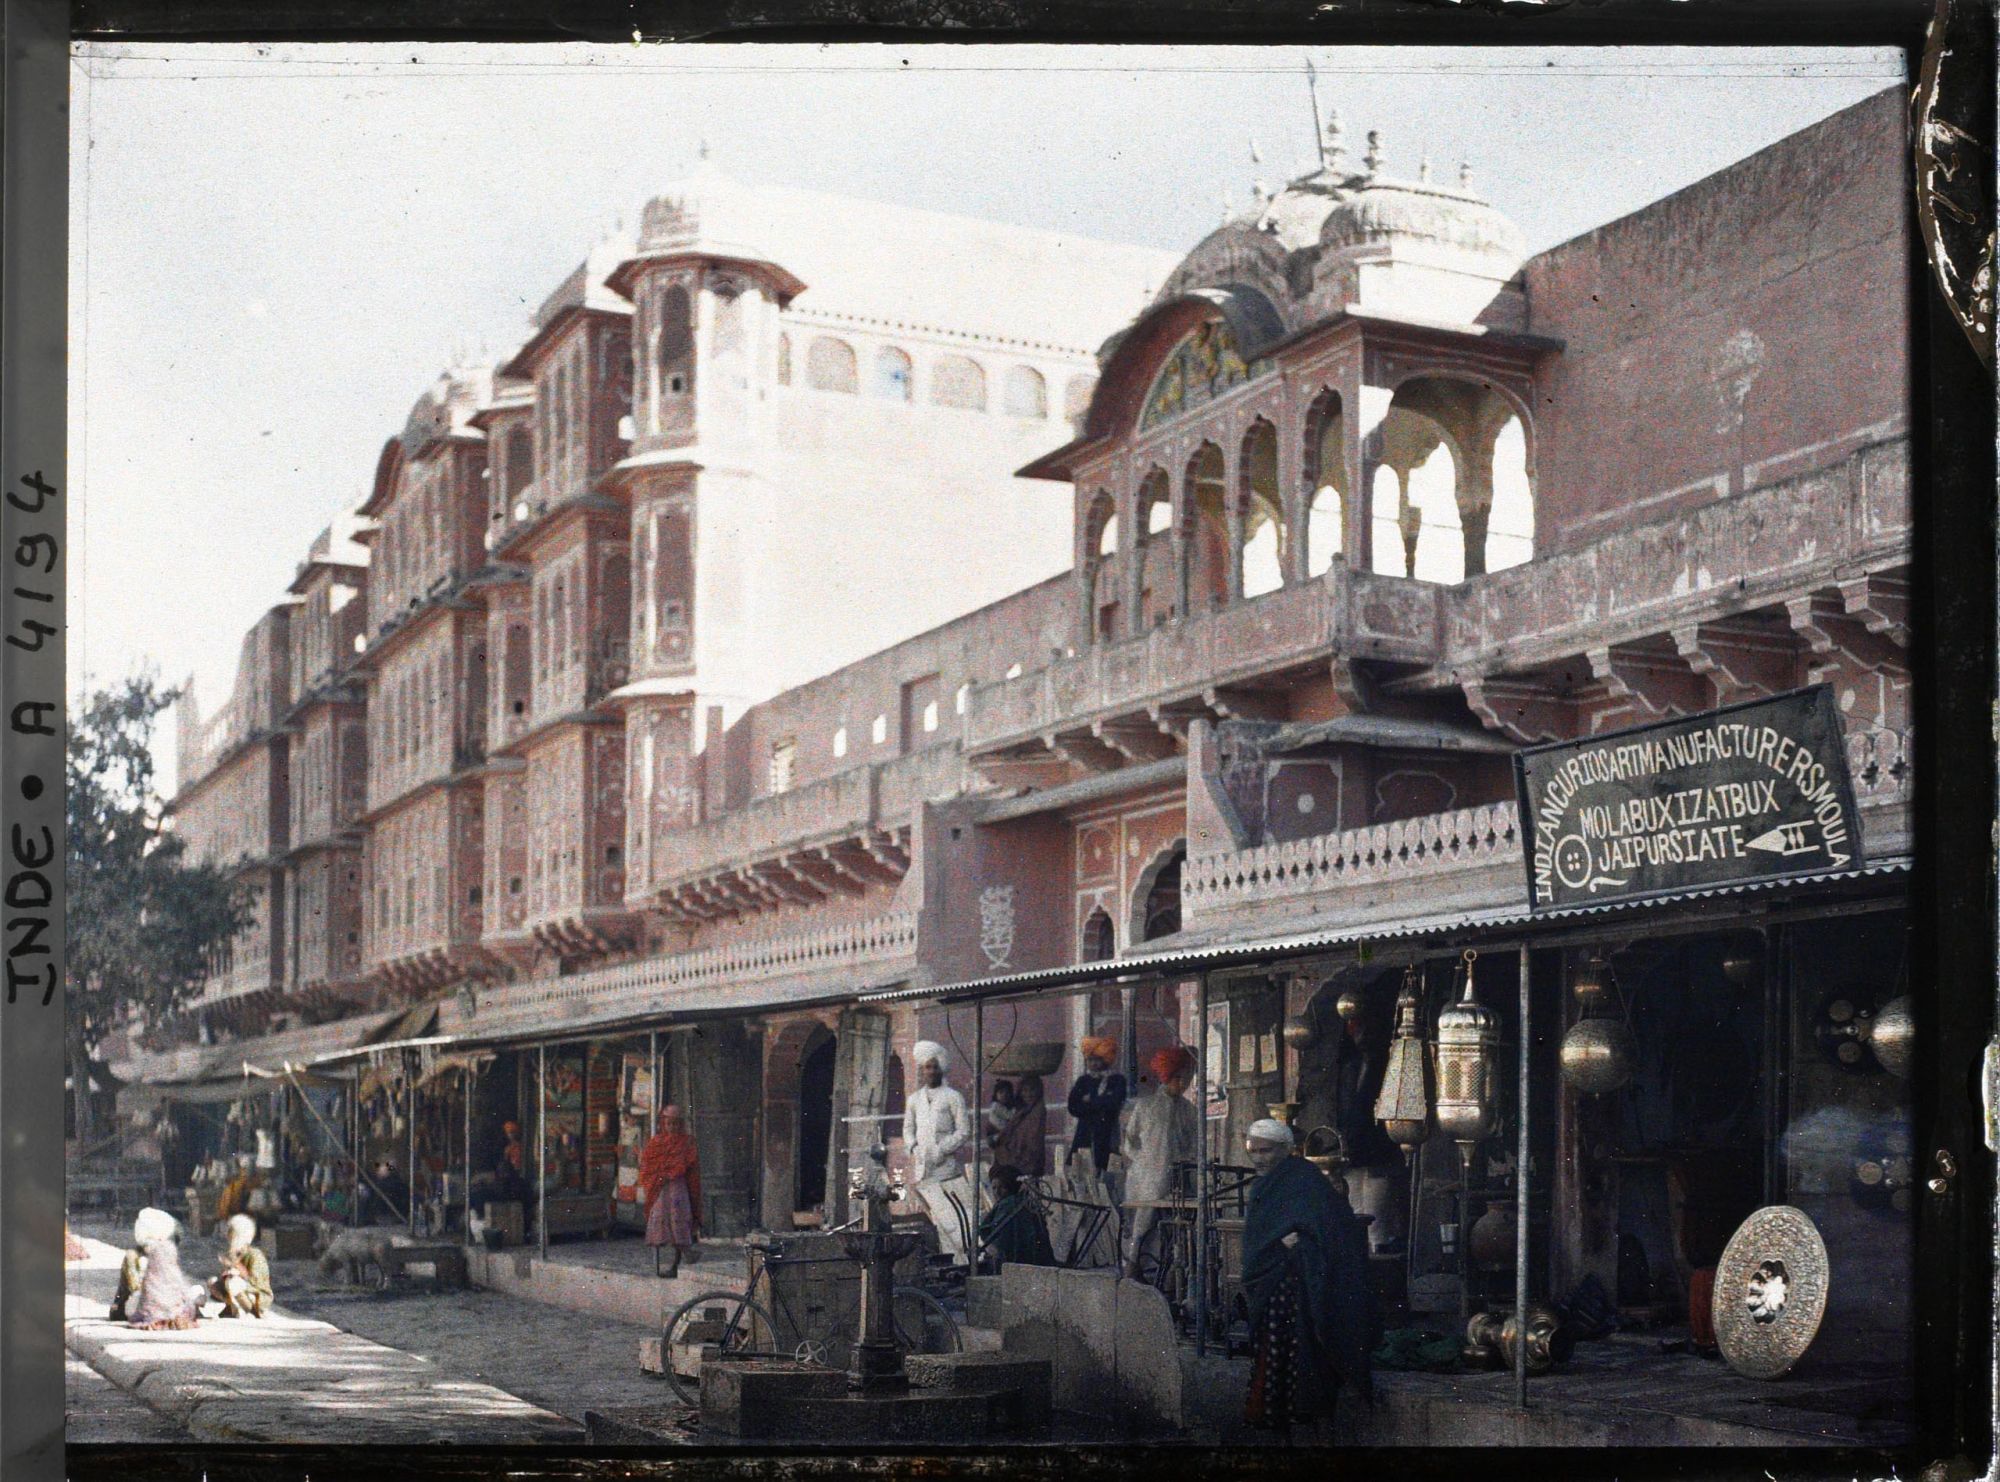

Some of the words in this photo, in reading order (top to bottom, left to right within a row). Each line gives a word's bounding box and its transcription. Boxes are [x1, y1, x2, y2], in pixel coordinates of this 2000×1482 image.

[6, 470, 57, 653] 4194
[12, 701, 56, 737] A
[6, 824, 56, 1006] INDE
